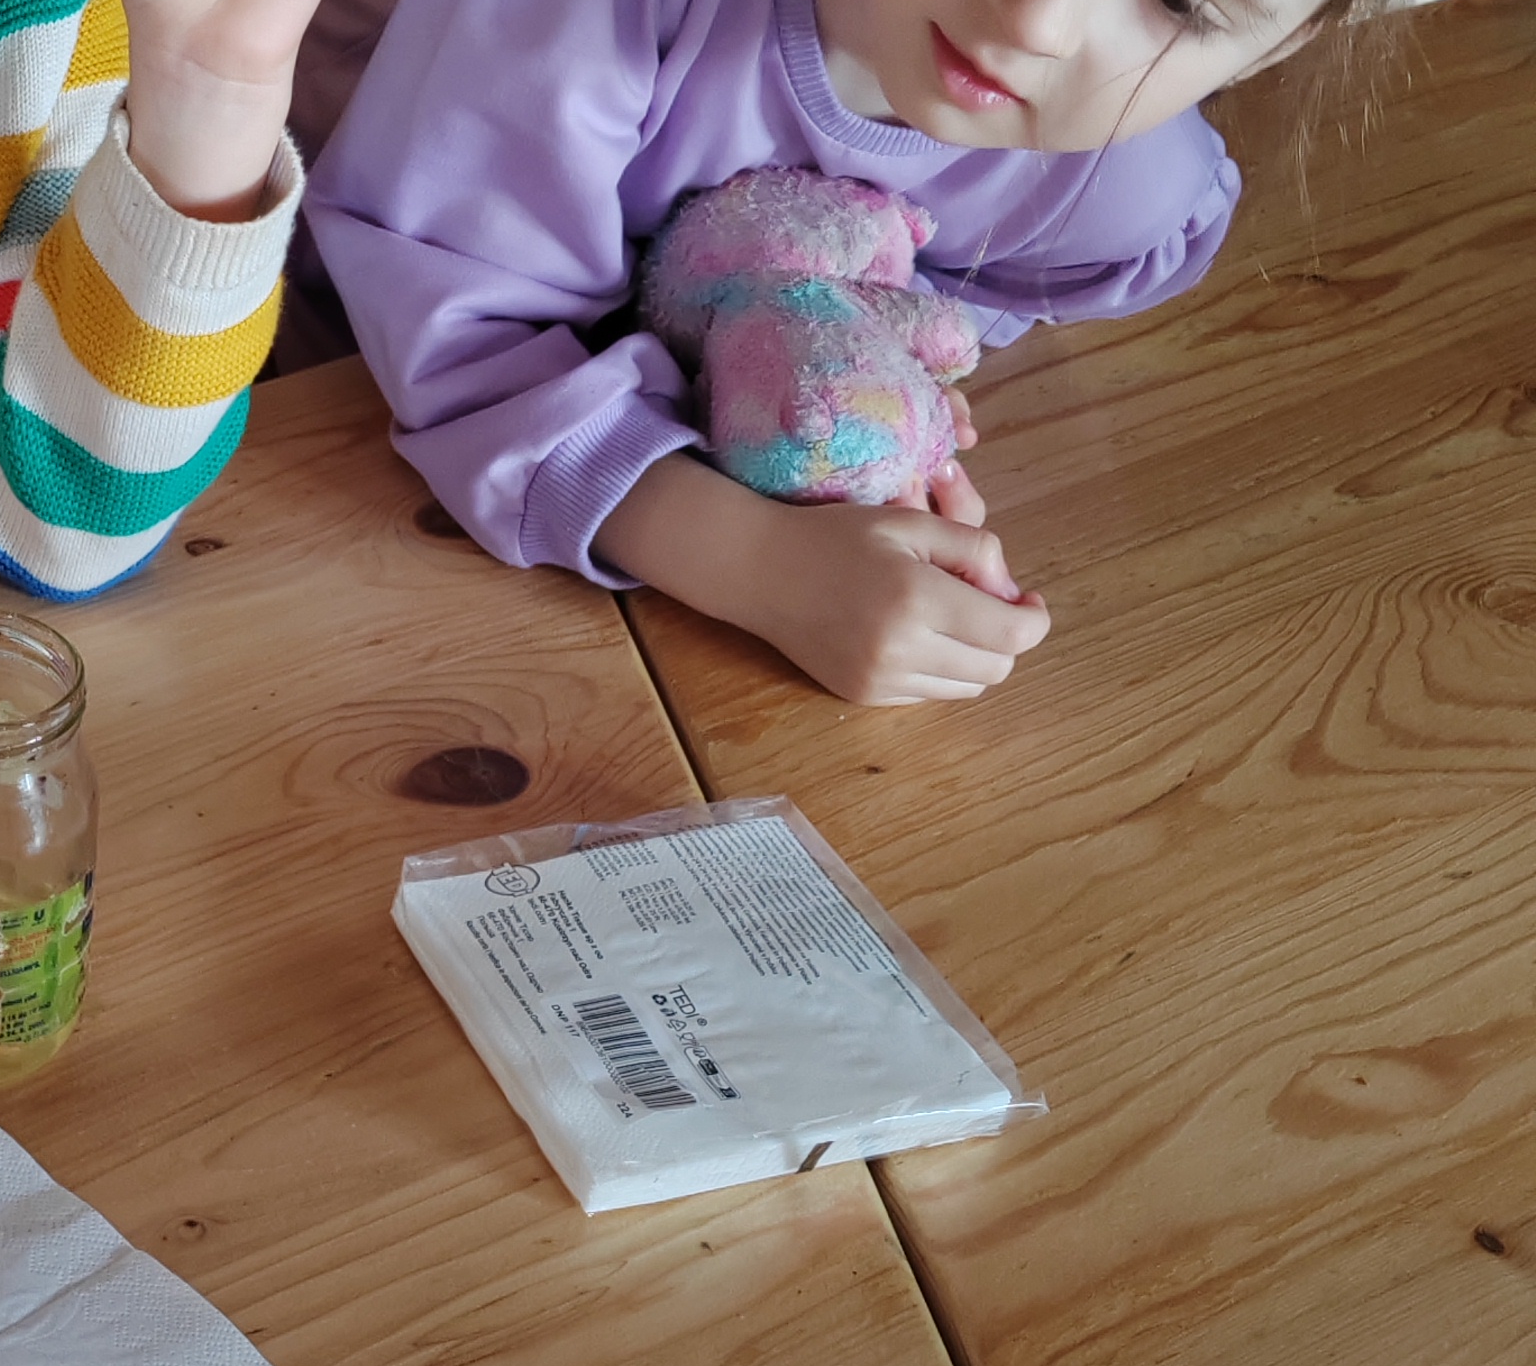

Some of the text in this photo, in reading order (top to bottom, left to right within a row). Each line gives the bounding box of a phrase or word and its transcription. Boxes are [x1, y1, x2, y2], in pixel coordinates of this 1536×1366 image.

[550, 1003, 579, 1036] DNP 117
[616, 1101, 633, 1118] 224
